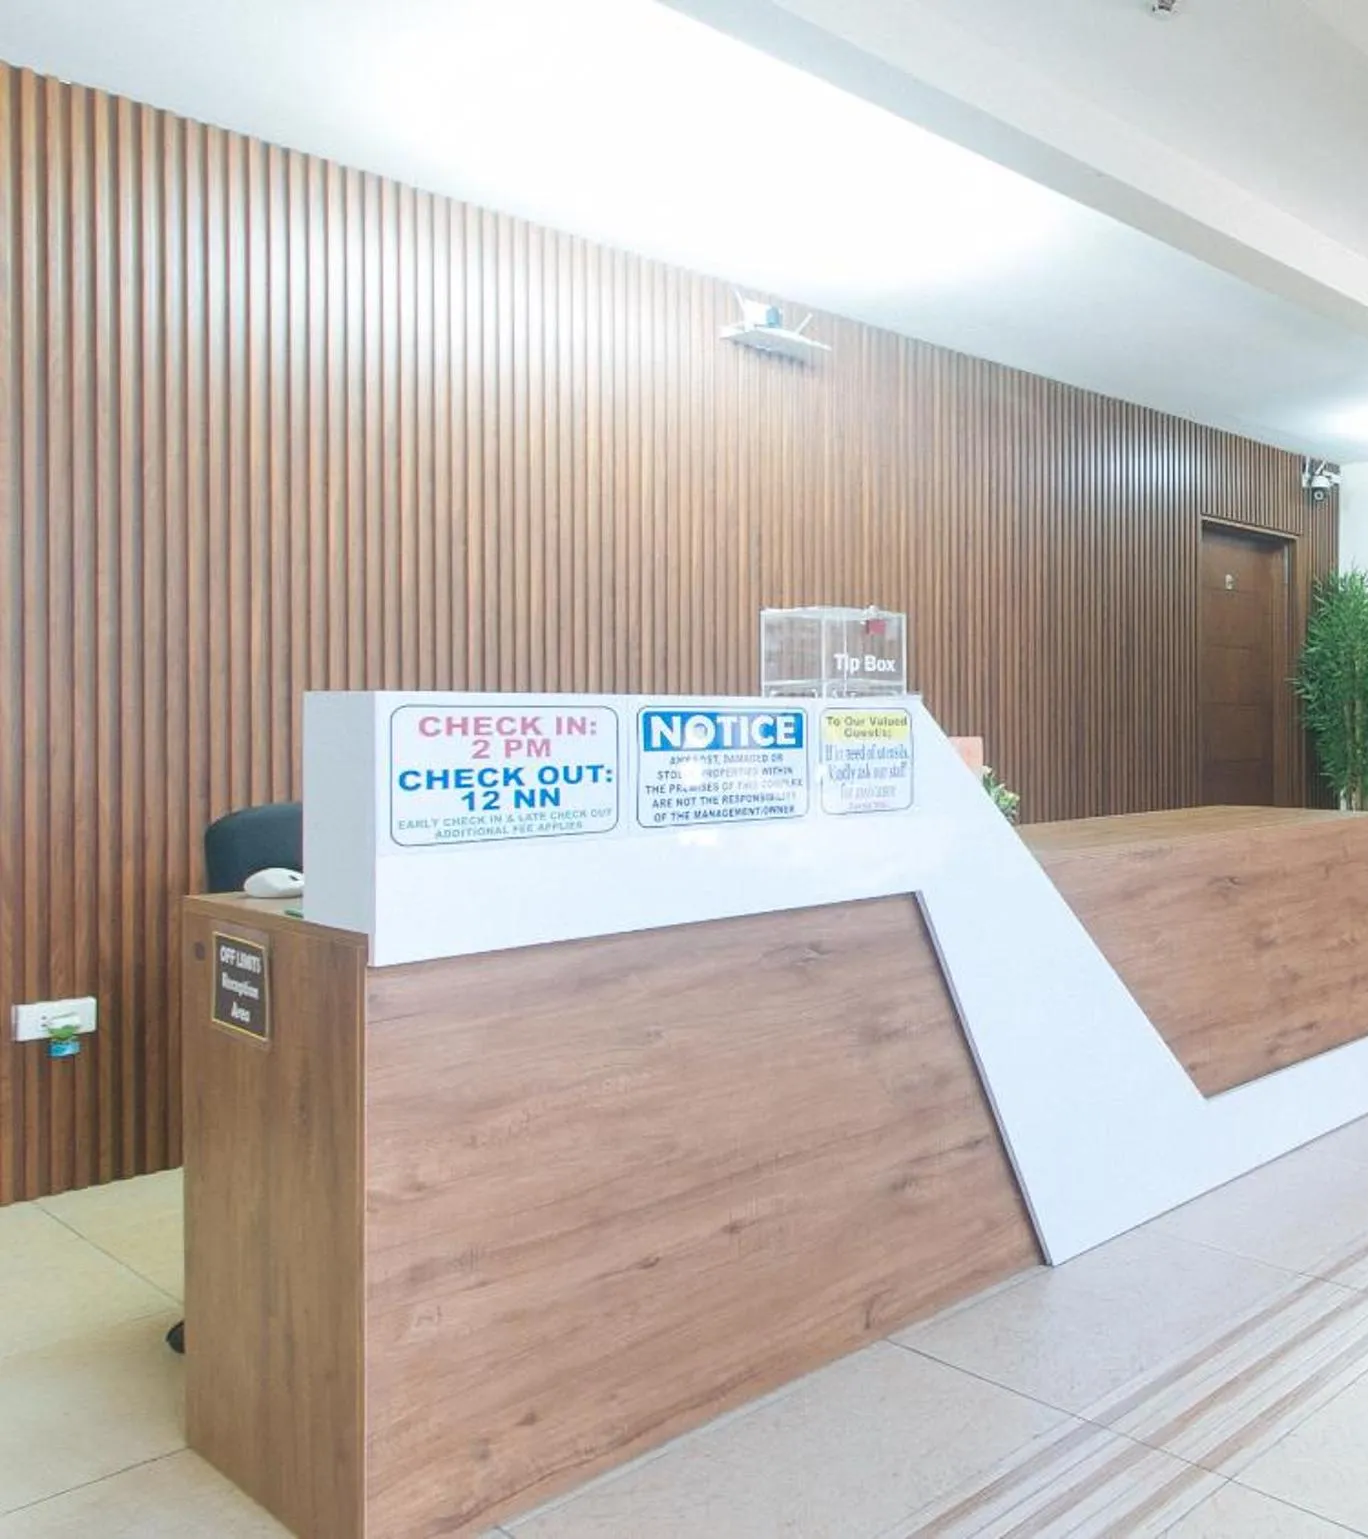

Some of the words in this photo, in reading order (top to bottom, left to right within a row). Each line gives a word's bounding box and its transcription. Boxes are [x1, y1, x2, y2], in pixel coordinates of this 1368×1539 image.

[833, 653, 861, 674] Tip
[864, 654, 896, 672] Box
[418, 716, 543, 737] CHECK
[555, 716, 597, 736] IN:
[651, 714, 796, 749] NOTICE
[826, 716, 841, 727] To
[472, 739, 490, 759] 2
[504, 738, 551, 758] PM
[771, 753, 784, 763] OR
[398, 767, 525, 791] CHECK
[538, 764, 613, 784] OUT:
[461, 791, 500, 811] 12
[514, 788, 560, 808] NN
[645, 784, 666, 795] THE
[652, 798, 673, 809] ARE
[676, 797, 697, 807] NOT
[699, 796, 719, 806] THE
[399, 818, 439, 830] EARLY
[443, 815, 485, 827] CHECK
[490, 814, 502, 825] IN
[518, 811, 546, 822] LATE
[549, 809, 587, 821] CHECK
[590, 808, 613, 818] OUT
[653, 812, 667, 823] OF
[670, 811, 690, 822] THE
[435, 826, 509, 840] ADDITIONAL
[513, 823, 534, 835] FEE
[537, 821, 583, 833] APPLIES
